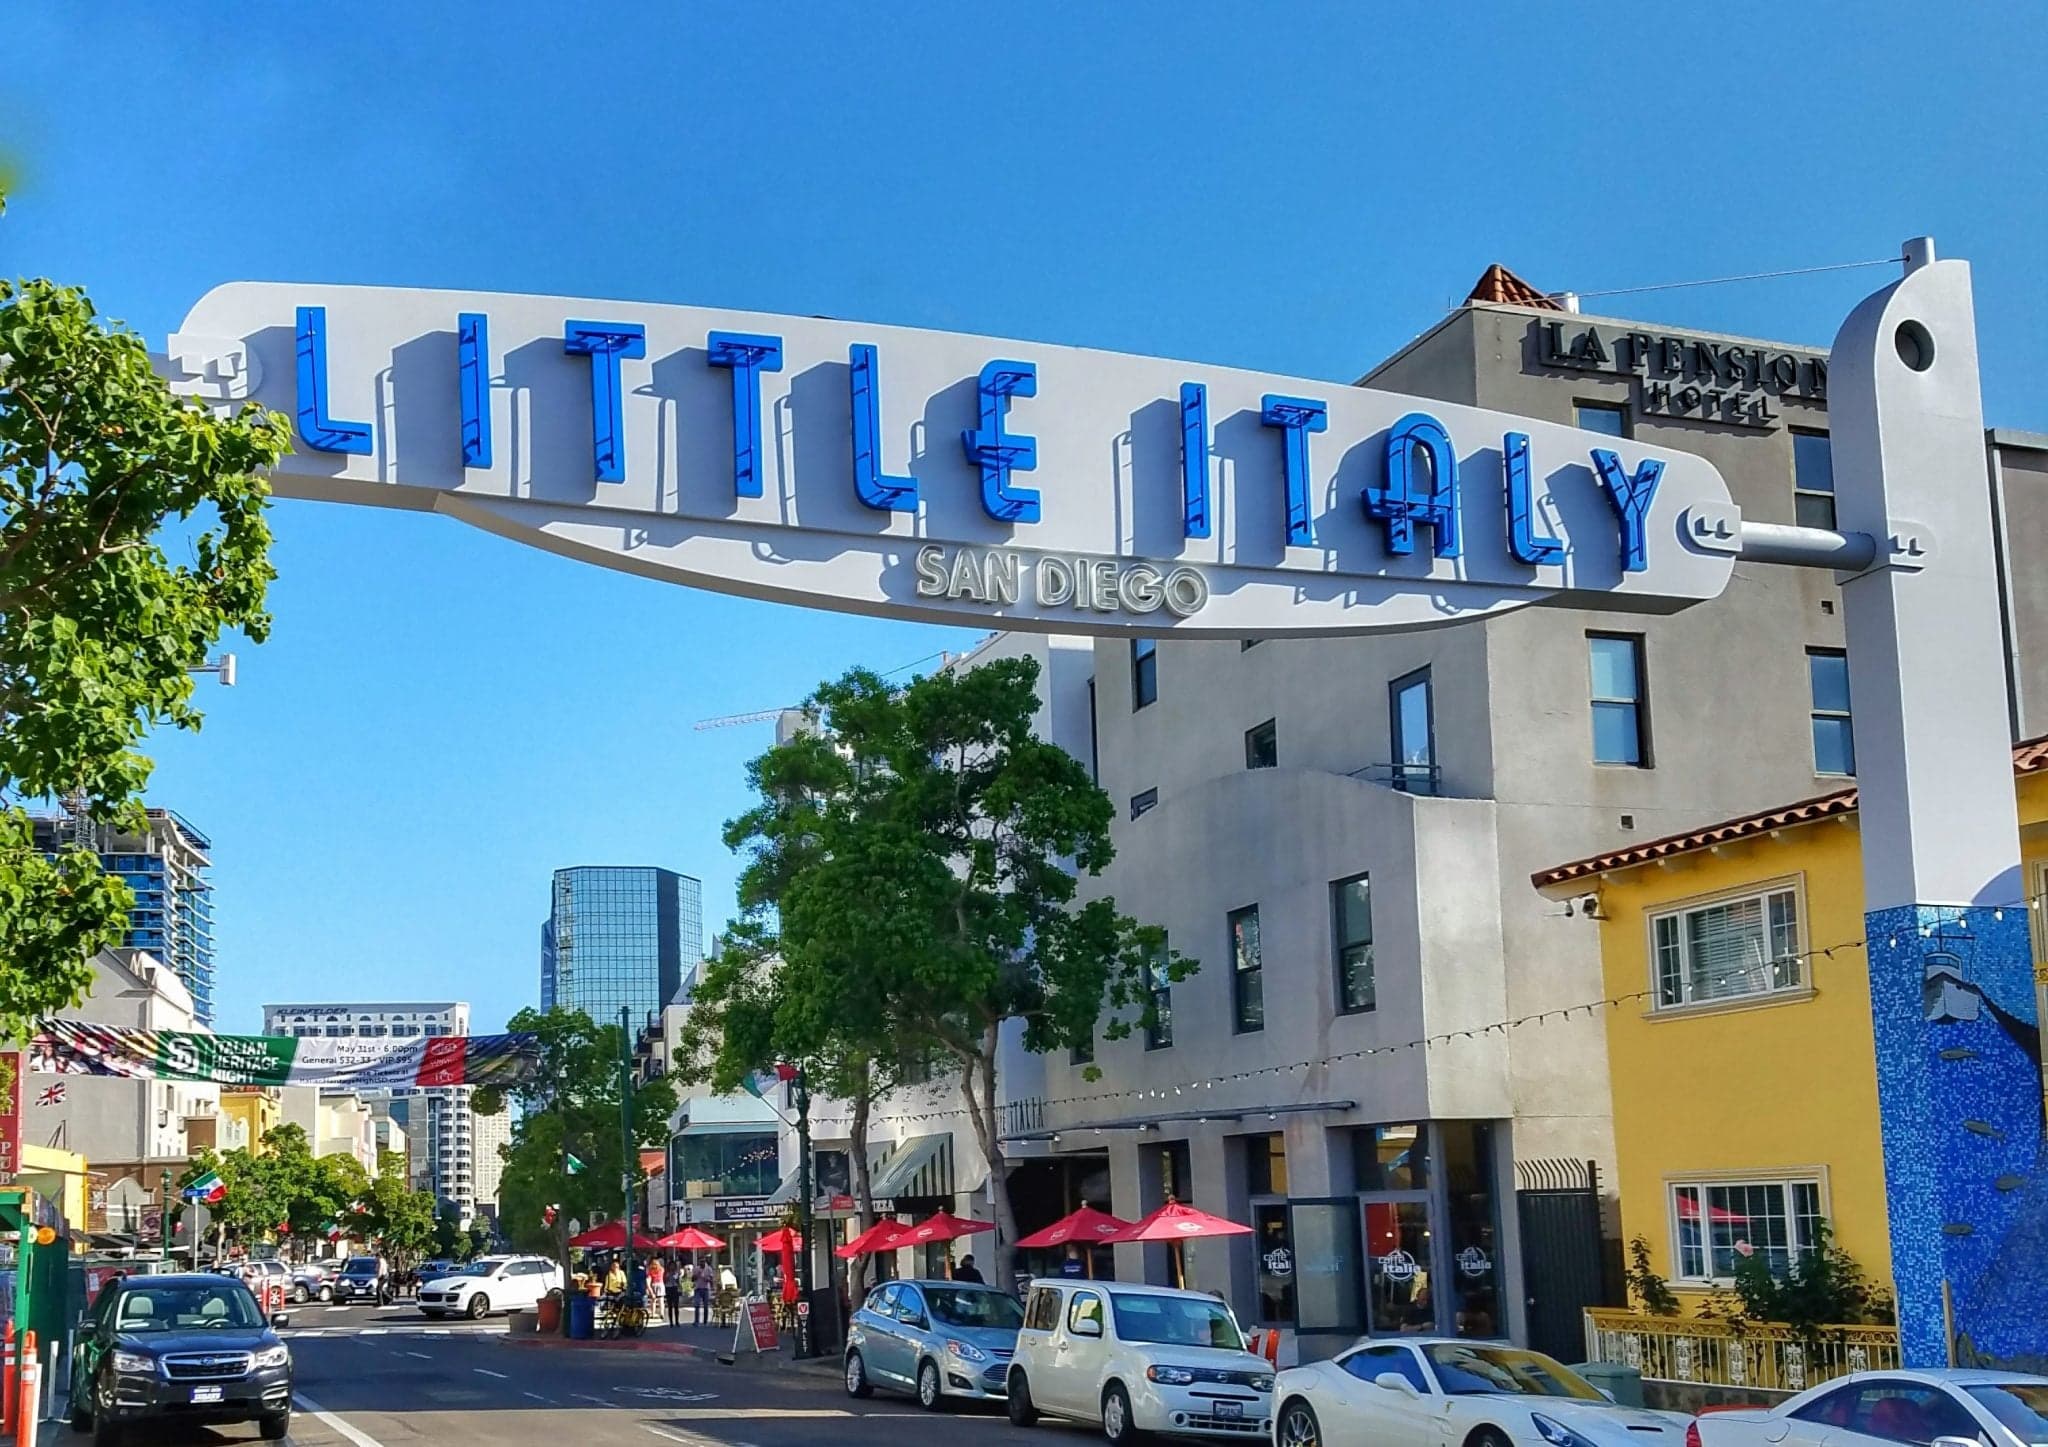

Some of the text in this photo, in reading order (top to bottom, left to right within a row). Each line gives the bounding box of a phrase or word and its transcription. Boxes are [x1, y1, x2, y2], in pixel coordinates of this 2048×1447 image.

[1549, 321, 1829, 392] LA PENSION
[1652, 381, 1779, 420] HOTEL
[296, 306, 1667, 573] LITTLE ITALY
[916, 545, 1210, 619] SAN DIEGO
[277, 1007, 349, 1016] KLEINFELDER
[211, 1054, 280, 1071] HERITAGE
[302, 1056, 337, 1064] General
[379, 1057, 394, 1065] VIP
[337, 1045, 355, 1055] May
[210, 1069, 256, 1084] NIGHT
[800, 1320, 808, 1353] VALET
